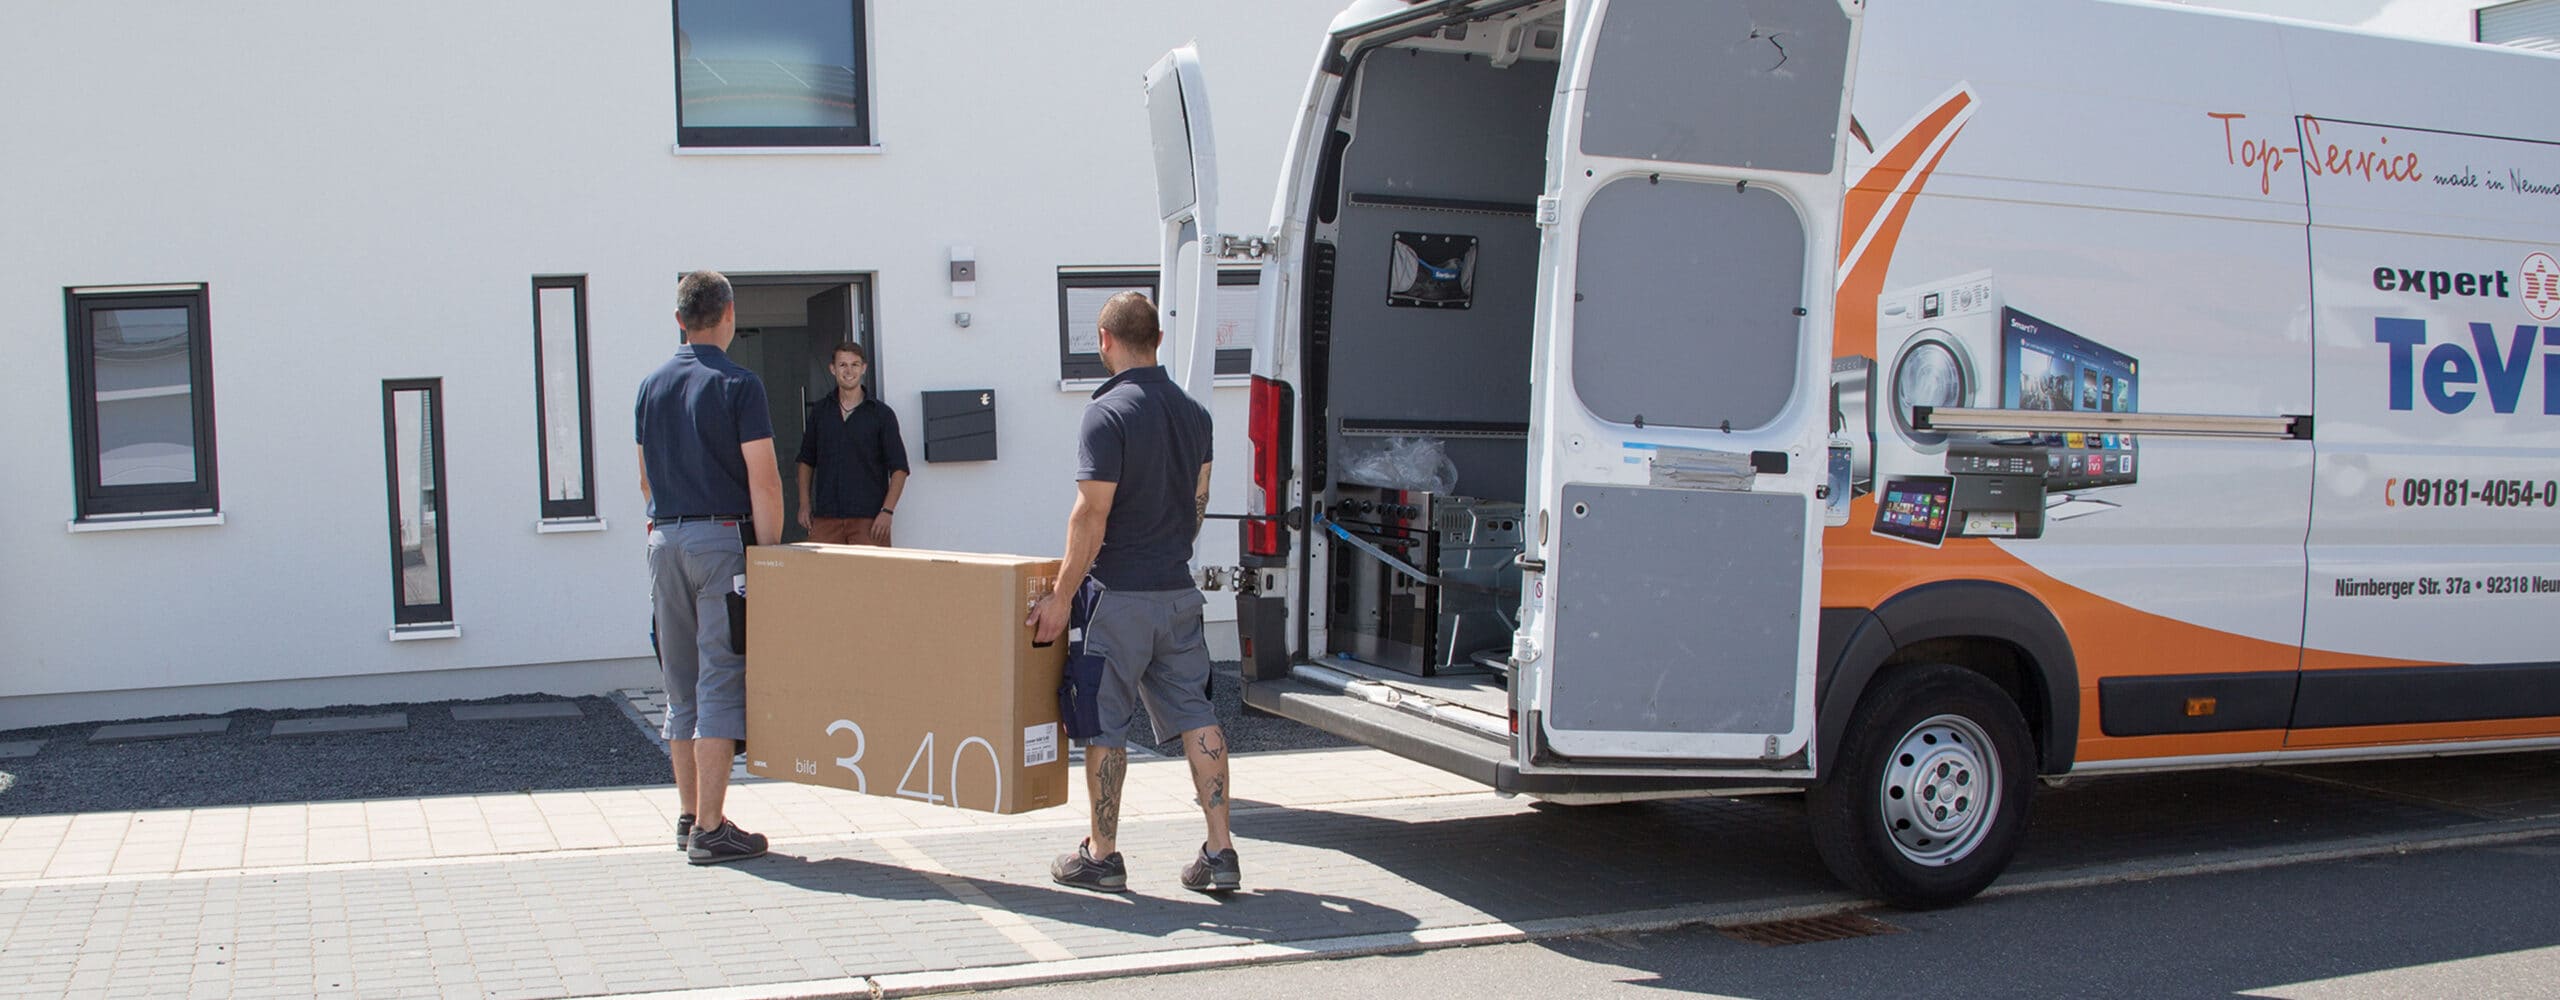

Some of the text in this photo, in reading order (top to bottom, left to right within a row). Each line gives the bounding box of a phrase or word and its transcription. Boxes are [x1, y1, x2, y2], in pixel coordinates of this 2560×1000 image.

[2208, 112, 2422, 194] Top-Service
[2433, 165, 2478, 188] made
[2485, 171, 2504, 190] in
[2373, 266, 2509, 300] expert
[2402, 478, 2557, 507] 09181-4054-0
[2335, 575, 2560, 600] Nürnberger Str. 37a 92318 Neu
[795, 758, 817, 776] bild
